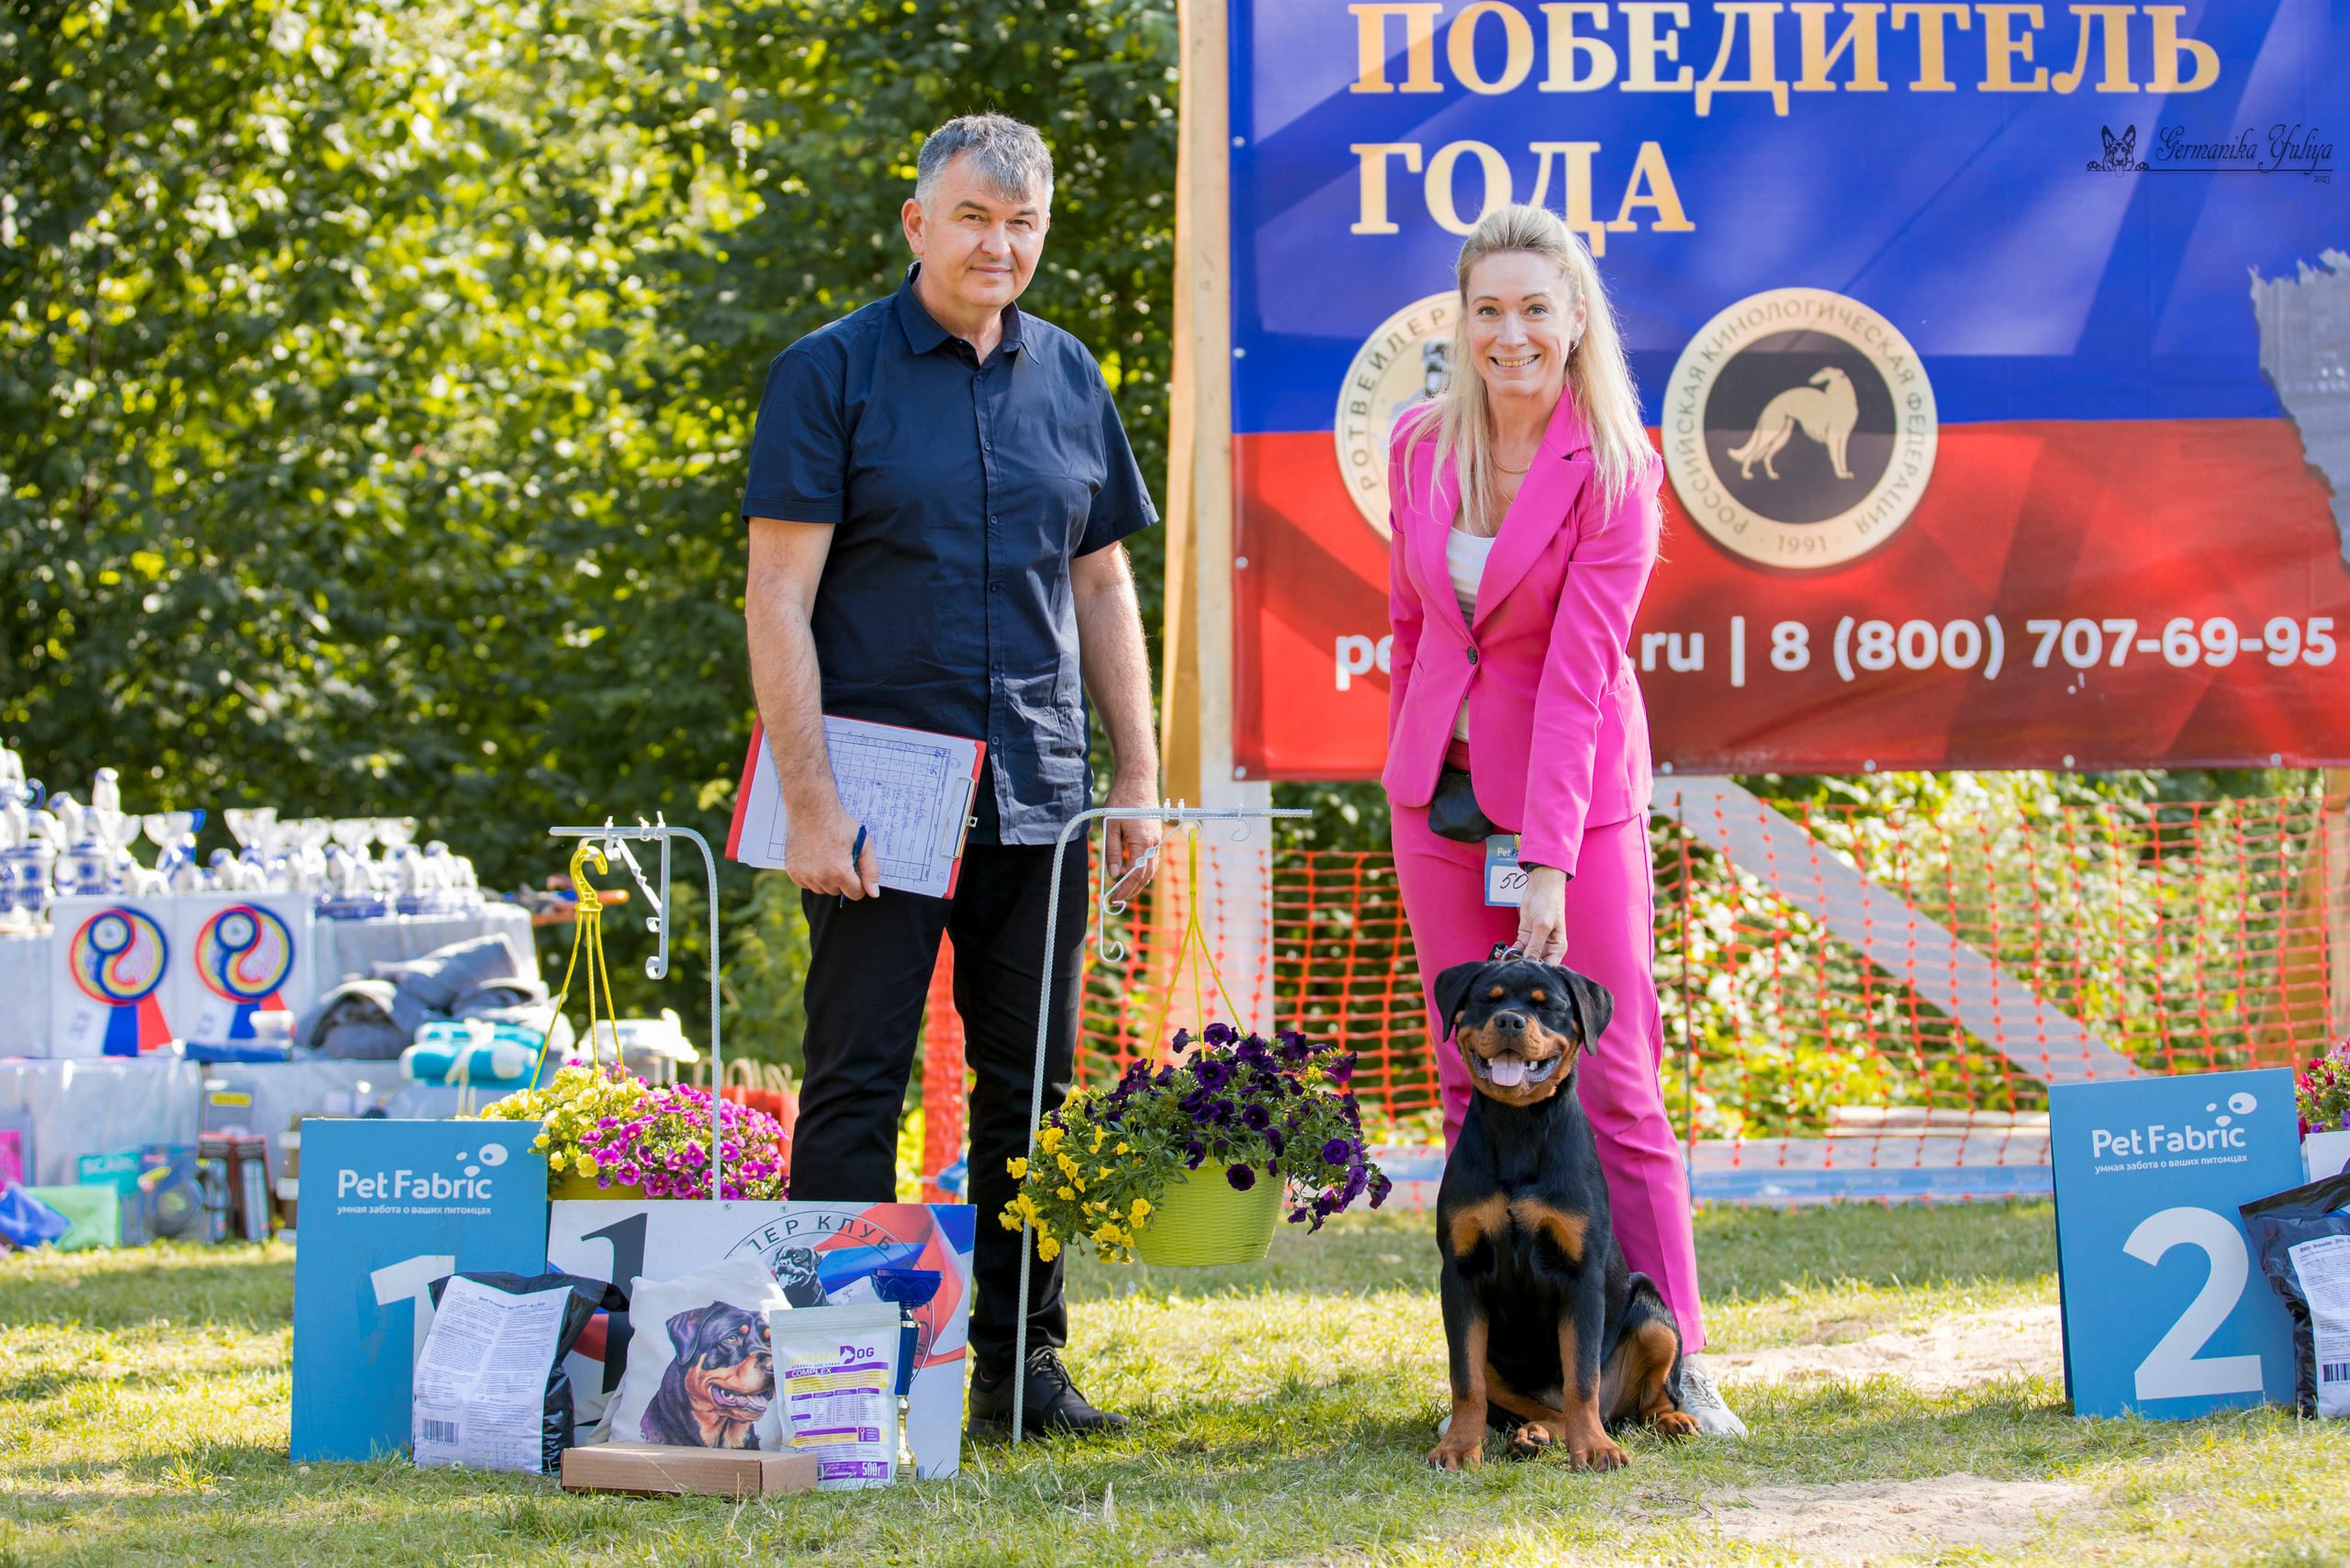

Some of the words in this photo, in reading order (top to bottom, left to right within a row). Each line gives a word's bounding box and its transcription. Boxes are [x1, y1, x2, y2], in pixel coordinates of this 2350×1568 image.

[1348, 1, 2220, 116] ПОБЕДИТЕЛЬ
[1350, 140, 1695, 257] ГОДА
[1702, 299, 1915, 386] КИНОЛОГИЧЕСКАЯ
[1675, 365, 1749, 534] РОССИЙСКАЯ
[1855, 392, 1927, 534] ФЕДЕРАЦИЯ
[1777, 535, 1827, 553] 1991
[1770, 622, 1810, 671] 8
[1834, 614, 2004, 682] (800)
[2026, 617, 2337, 667] 707-69-95
[1497, 846, 1511, 857] Pet
[2092, 1129, 2143, 1158] Pet
[2148, 1125, 2246, 1154] Fabric
[2095, 1163, 2124, 1174] умная
[2126, 1160, 2158, 1170] забота
[2168, 1157, 2199, 1167] ваших
[2200, 1154, 2248, 1165] питомцах
[338, 1169, 388, 1199] Pet
[394, 1169, 493, 1200] Fabric
[337, 1205, 367, 1215] умная
[368, 1204, 401, 1215] забота
[411, 1206, 442, 1215] ваших
[443, 1206, 492, 1215] питомцах
[818, 1215, 894, 1251] КЛУБ
[2122, 1206, 2264, 1401] 2
[791, 1351, 838, 1364] AMINO
[791, 1367, 832, 1377] COMPLEX
